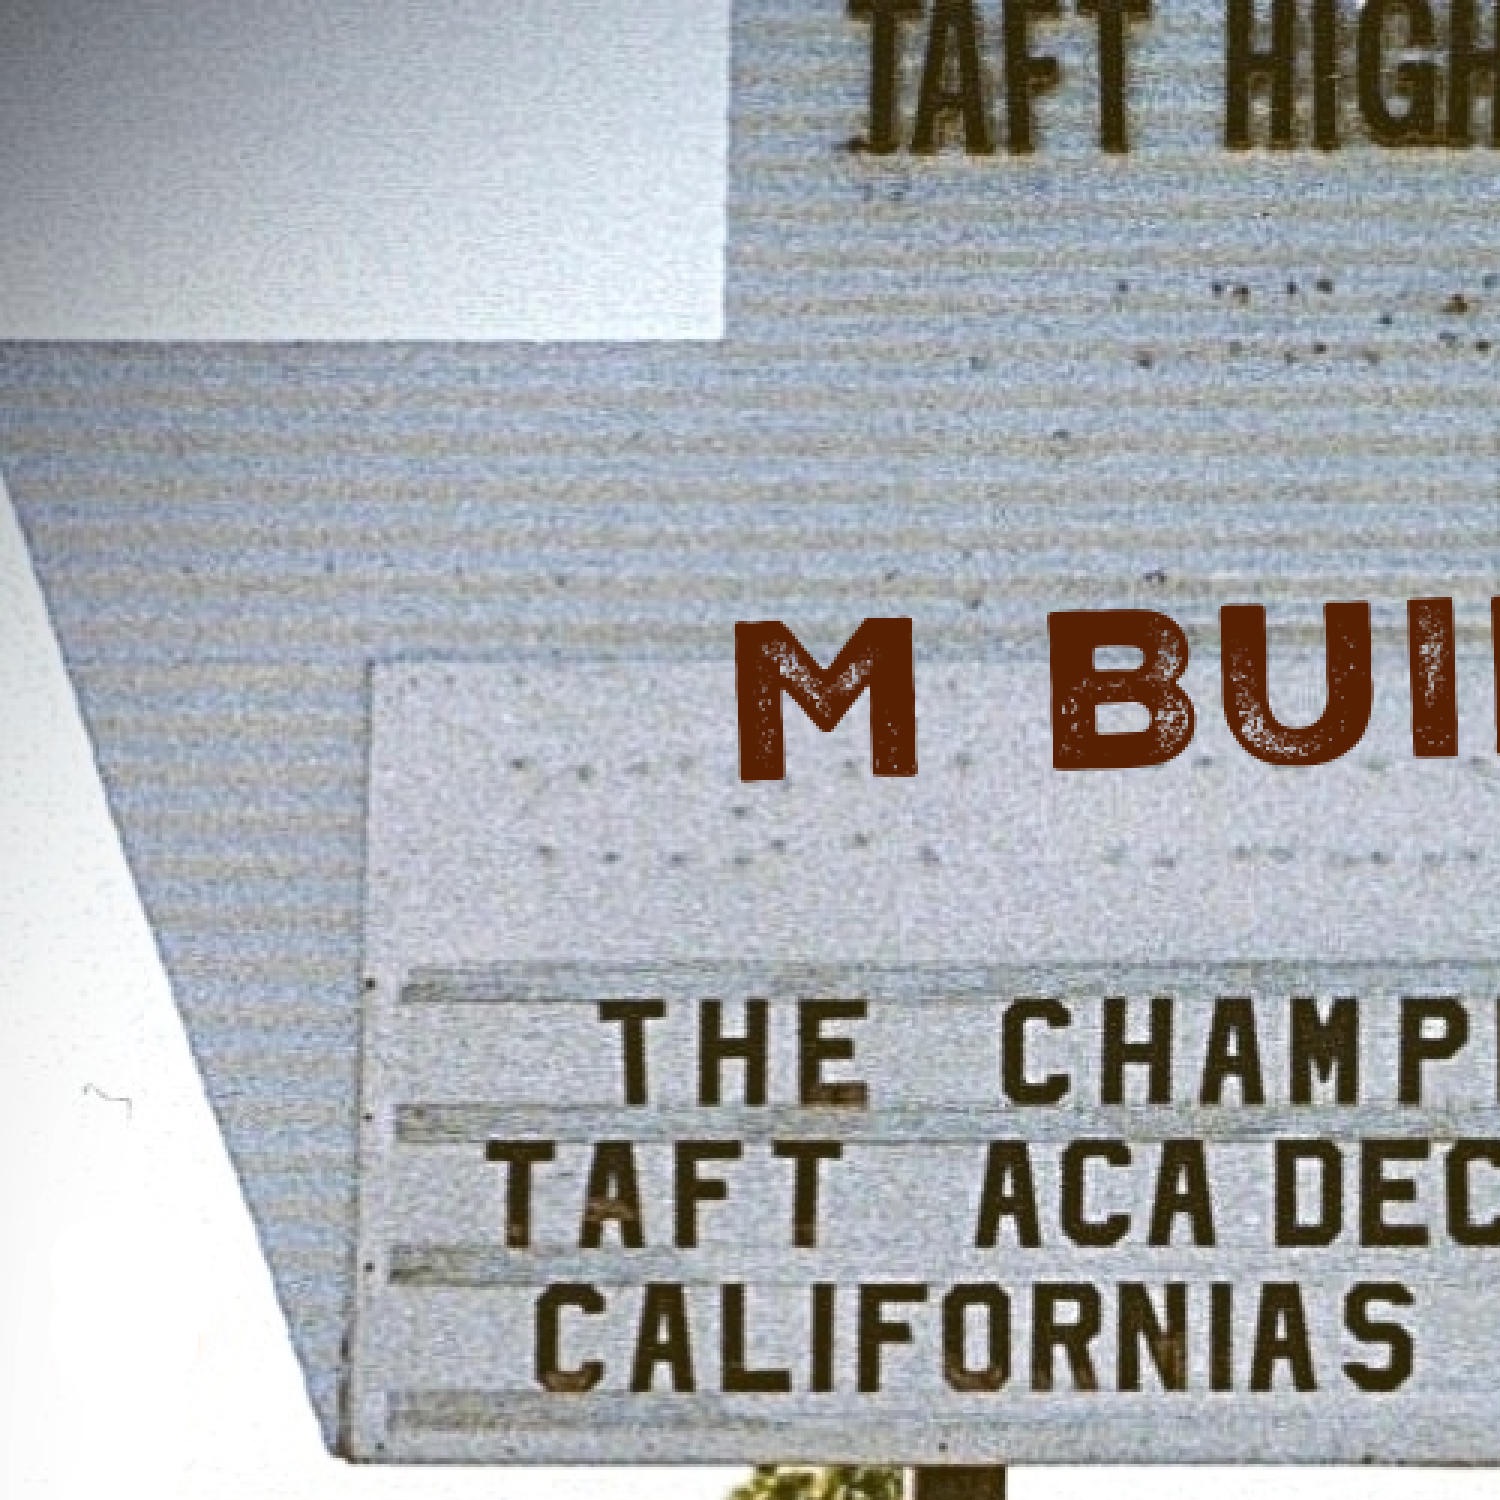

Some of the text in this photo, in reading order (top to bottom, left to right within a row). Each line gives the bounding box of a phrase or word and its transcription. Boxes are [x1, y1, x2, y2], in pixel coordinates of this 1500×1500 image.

[846, 0, 1153, 156] TAFT
[597, 998, 868, 1108] THE
[485, 1139, 844, 1249] TAFT
[535, 1281, 1415, 1394] CALIFORNIAS
